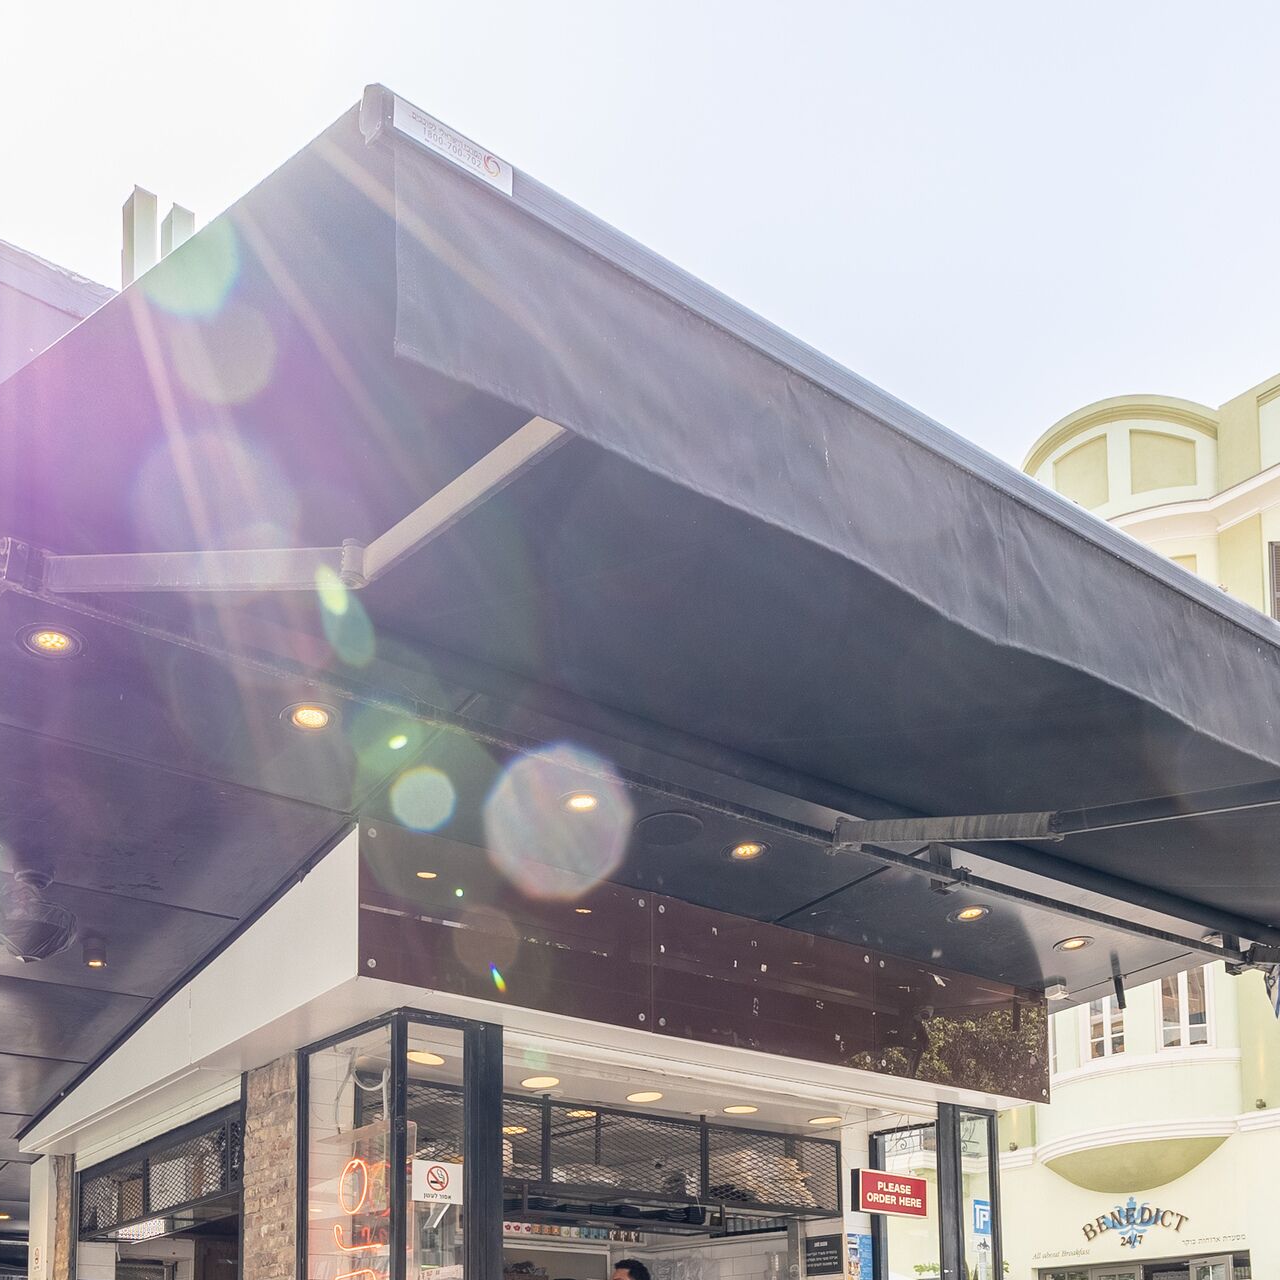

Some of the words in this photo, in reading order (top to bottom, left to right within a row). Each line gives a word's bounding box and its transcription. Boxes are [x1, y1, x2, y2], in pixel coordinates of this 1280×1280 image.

[877, 1181, 912, 1195] PLEASE
[866, 1192, 897, 1205] ORDER
[898, 1196, 922, 1208] HERE
[1082, 1206, 1189, 1242] BENEDICT
[1120, 1234, 1144, 1247] 24/7
